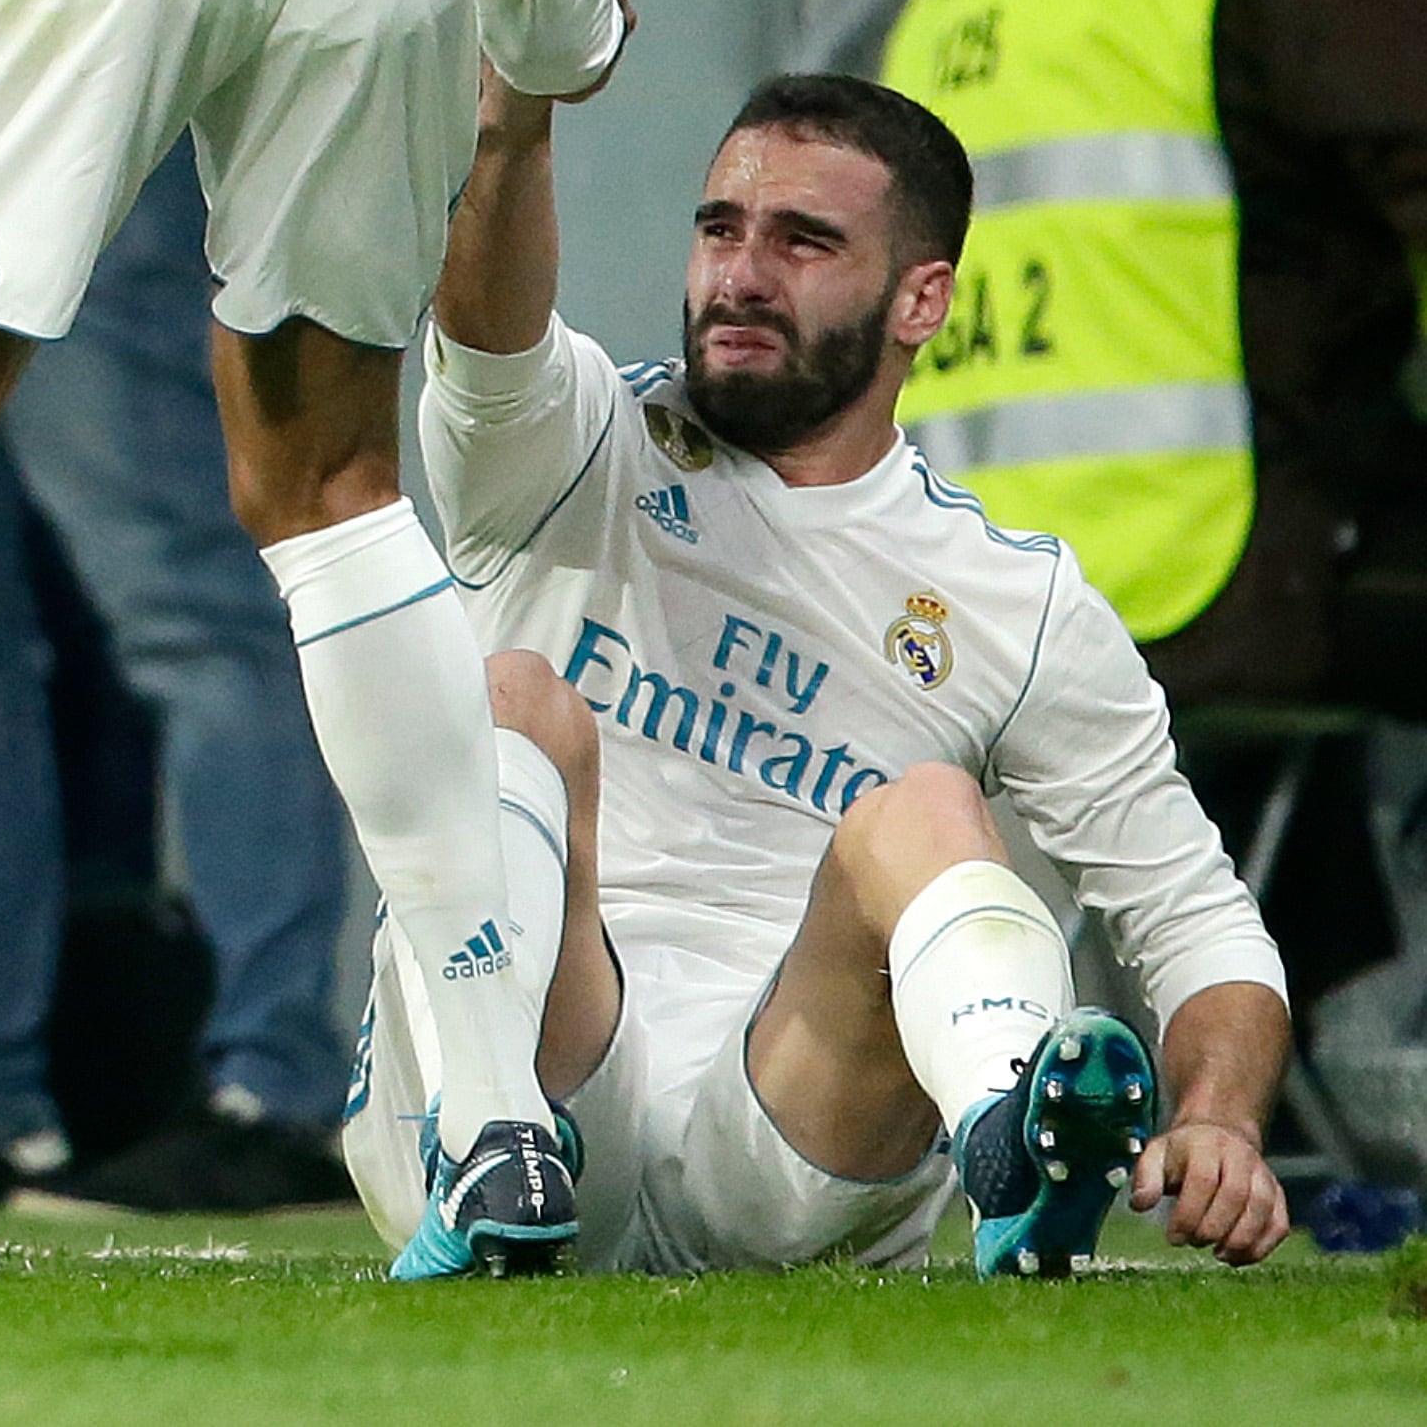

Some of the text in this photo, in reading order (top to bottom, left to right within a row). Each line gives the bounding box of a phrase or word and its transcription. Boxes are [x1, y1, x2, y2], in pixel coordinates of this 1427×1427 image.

[1019, 257, 1054, 357] 2
[713, 613, 830, 715] Fly
[563, 616, 889, 815] Emirate
[442, 951, 512, 981] adidas
[951, 996, 1063, 1026] RMC
[520, 1129, 546, 1220] TIEMPO
